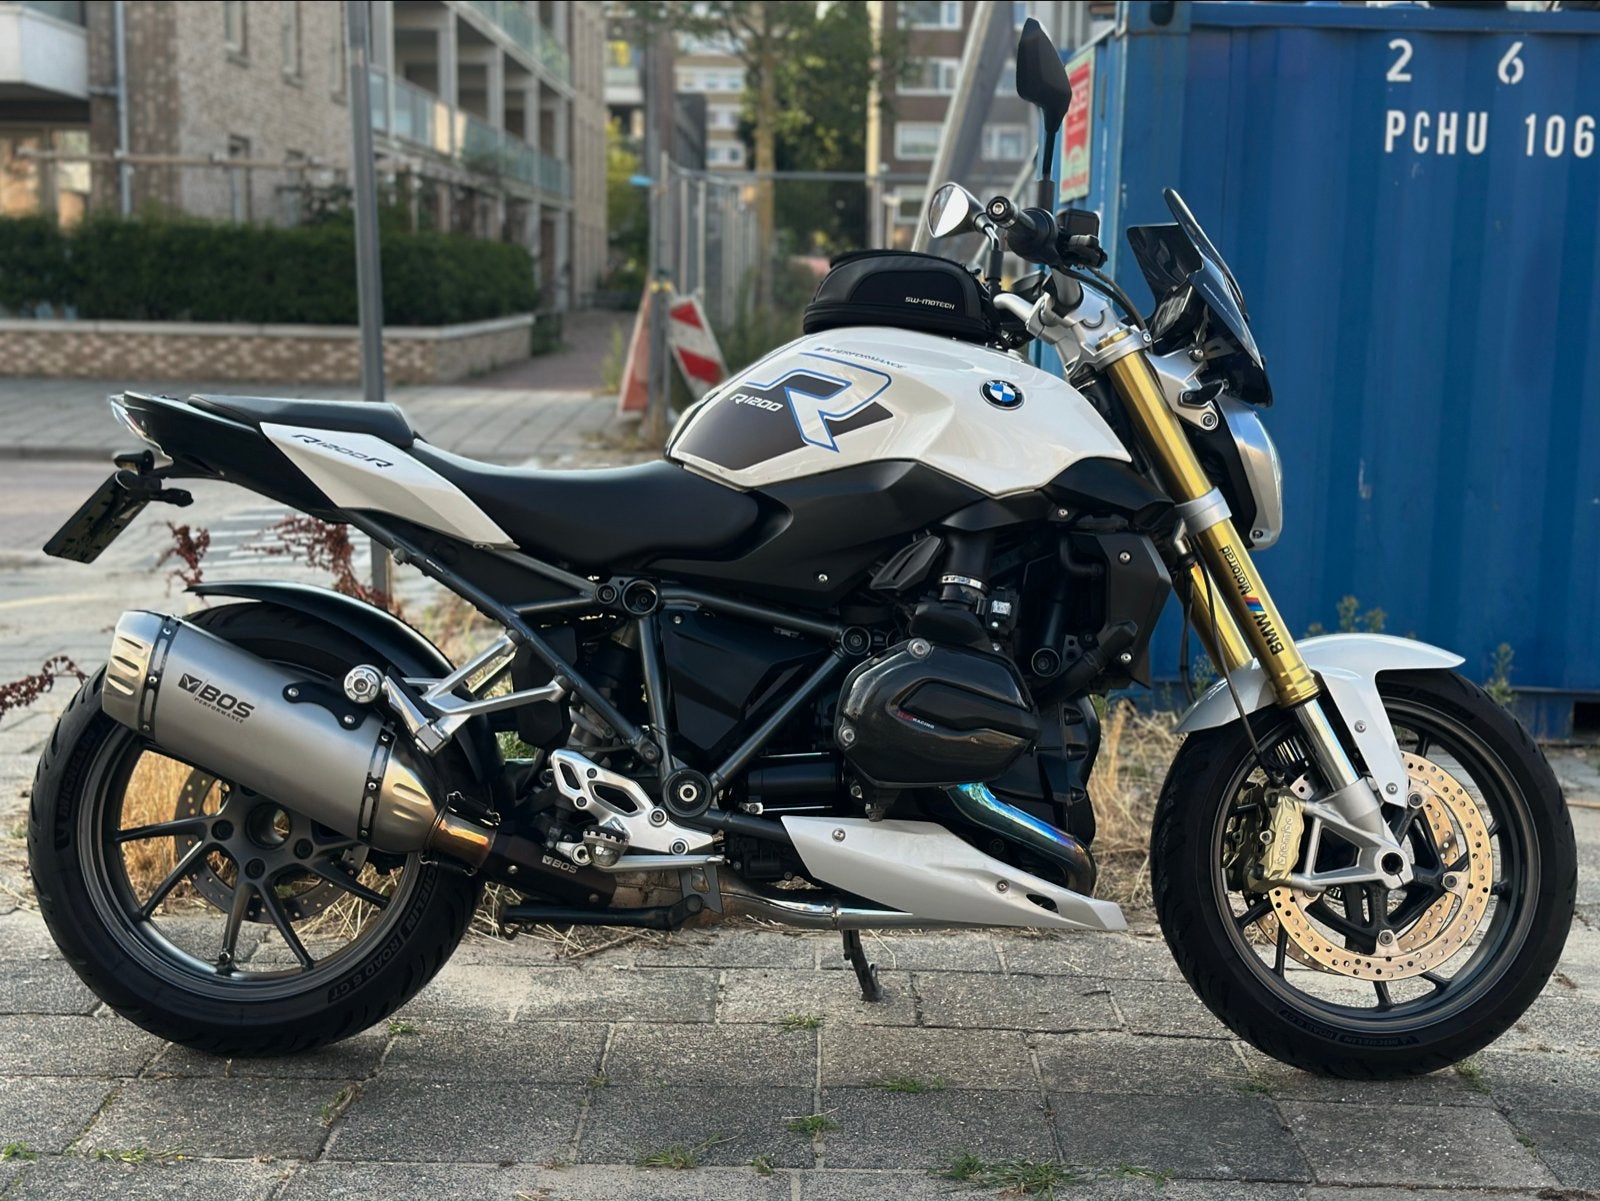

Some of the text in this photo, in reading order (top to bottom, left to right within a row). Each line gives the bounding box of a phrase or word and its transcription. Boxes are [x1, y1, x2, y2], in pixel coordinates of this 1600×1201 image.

[1386, 38, 1525, 85] 2 6
[1384, 110, 1596, 159] PCHU 106
[905, 296, 955, 310] SW-MOTECH
[1219, 545, 1285, 656] BMW Motorrad
[194, 698, 244, 724] PERFORMANCE
[198, 684, 255, 719] BOS
[1275, 816, 1294, 866] brembo
[551, 858, 579, 874] BOS
[366, 938, 400, 976] ROAD
